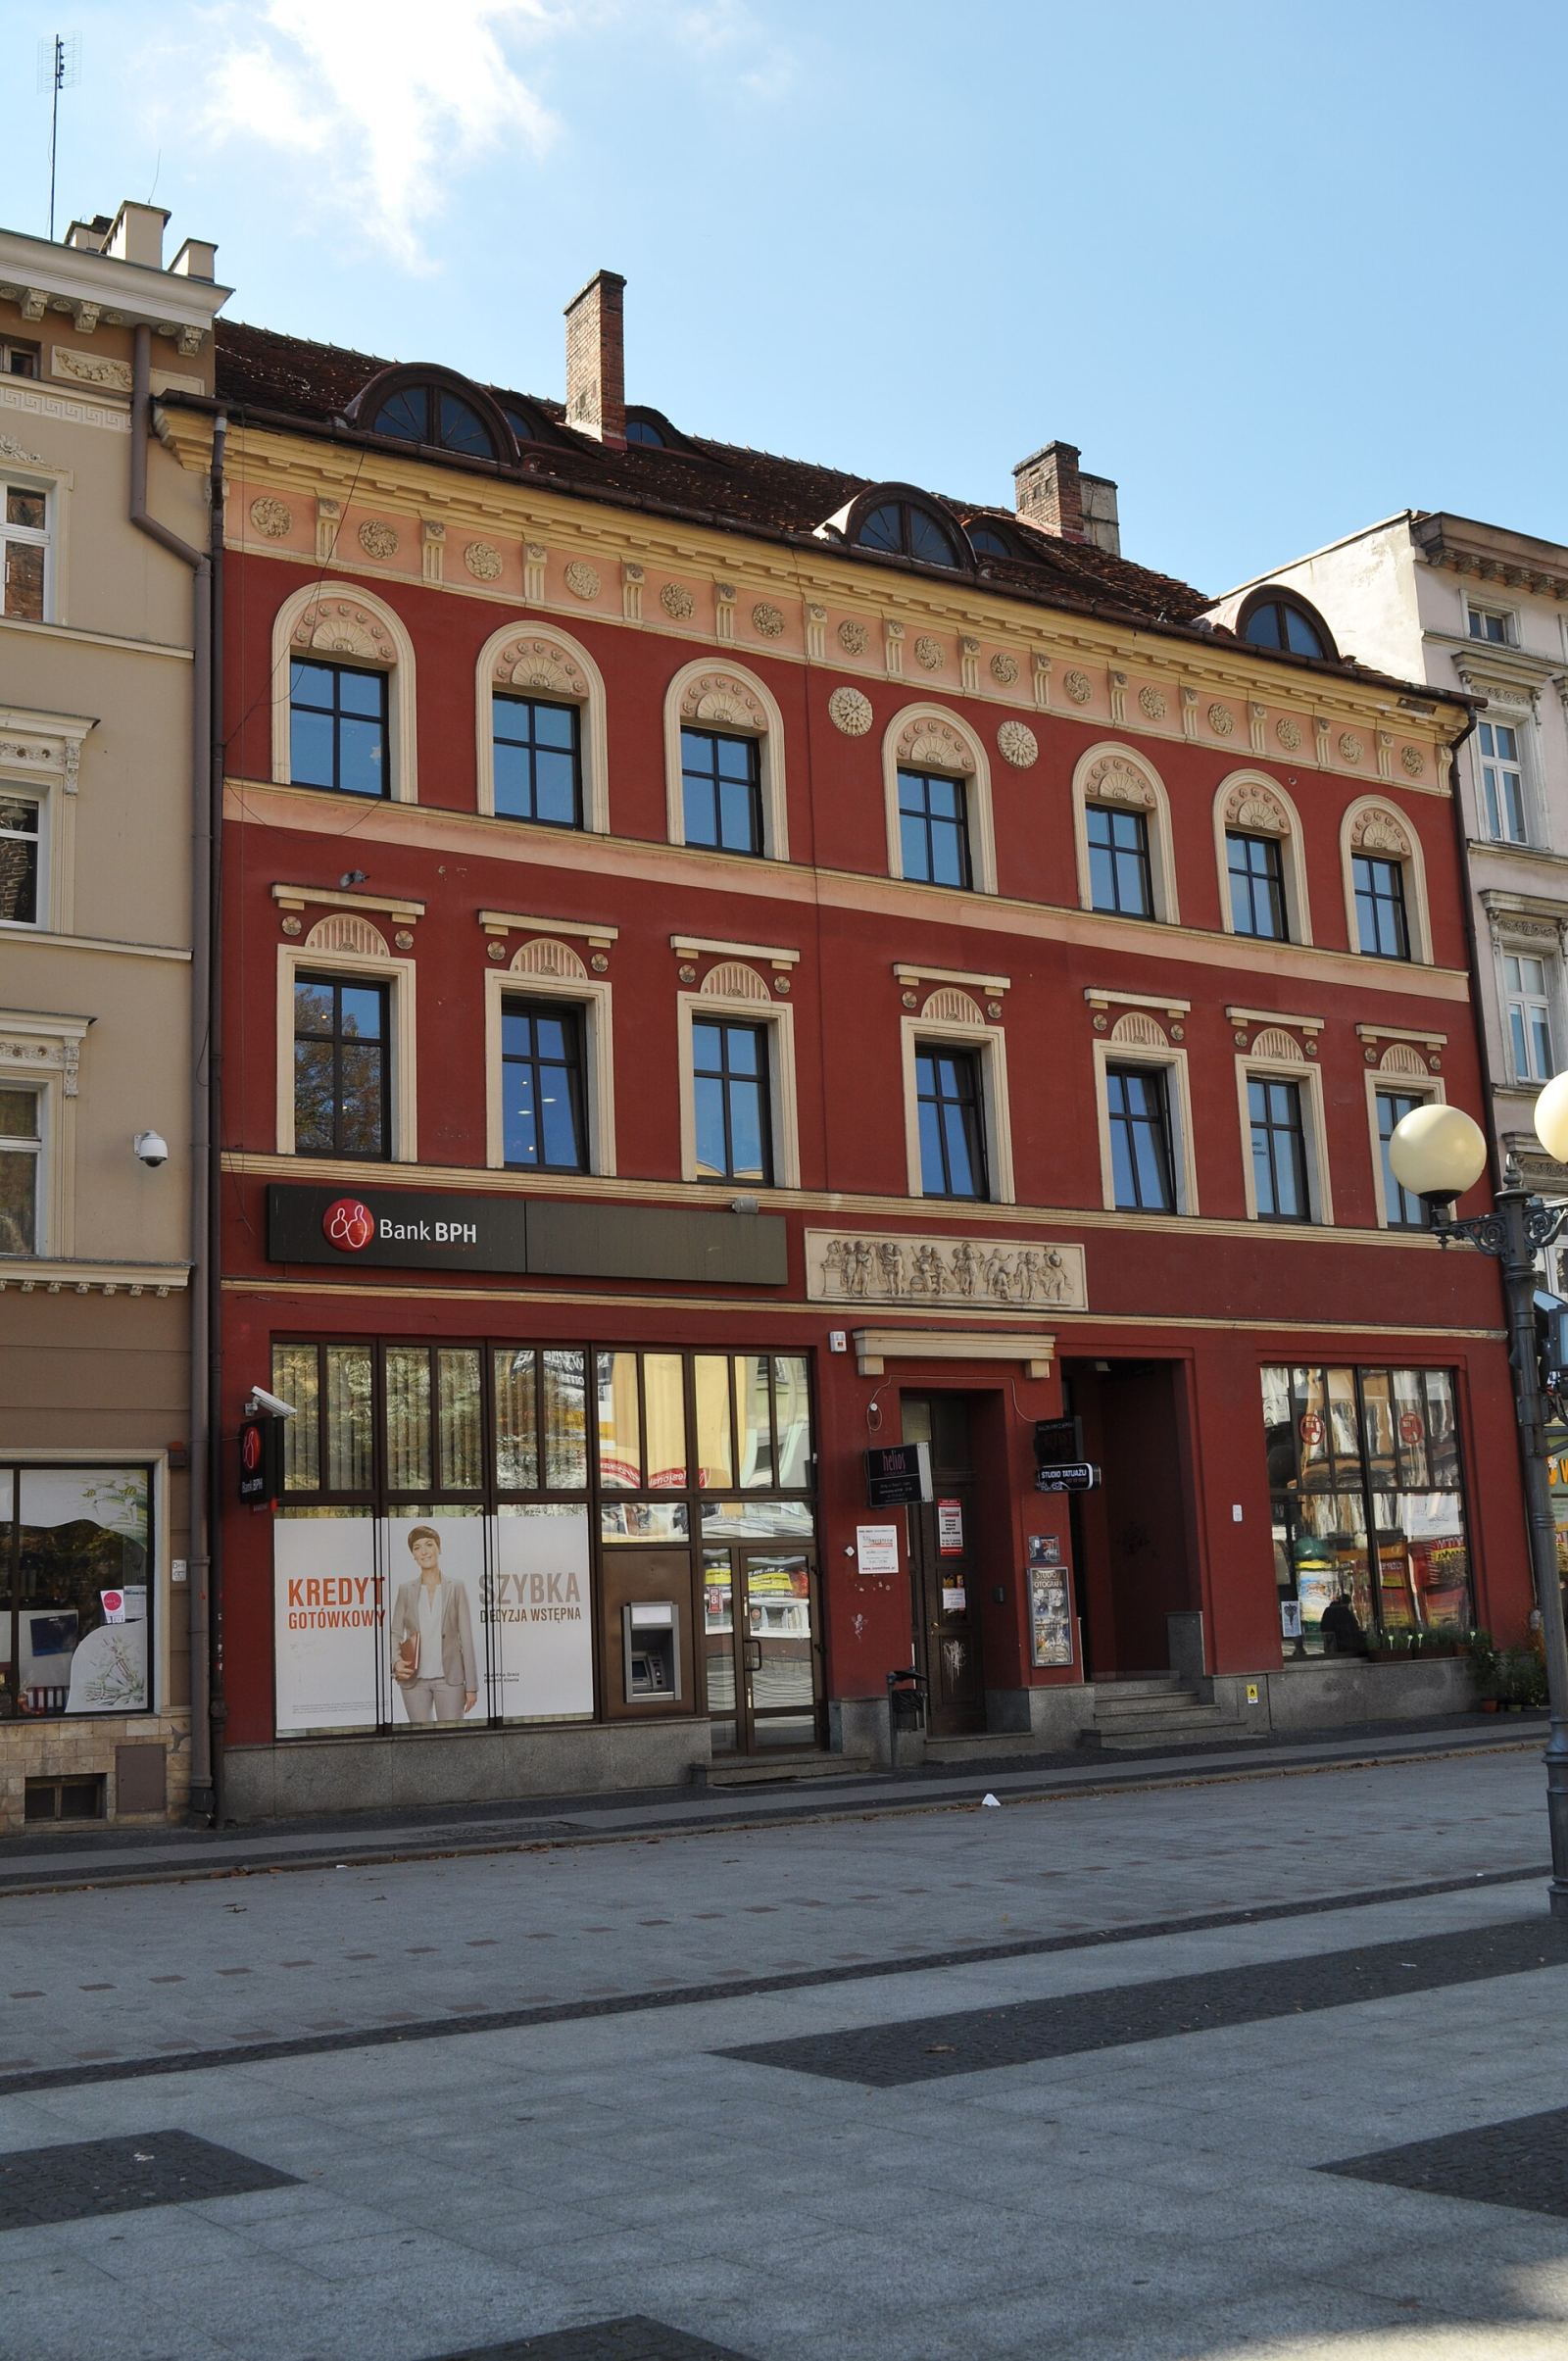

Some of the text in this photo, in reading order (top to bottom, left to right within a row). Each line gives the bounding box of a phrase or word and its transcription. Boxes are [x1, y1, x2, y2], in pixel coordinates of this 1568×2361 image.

[379, 1218, 476, 1243] Bank BPH
[288, 1576, 386, 1607] KREDYT
[478, 1572, 581, 1605] SZYBKA
[288, 1607, 386, 1630] GOTÓWKOWY
[480, 1607, 581, 1623] DECYZJA WSTĘPNA
